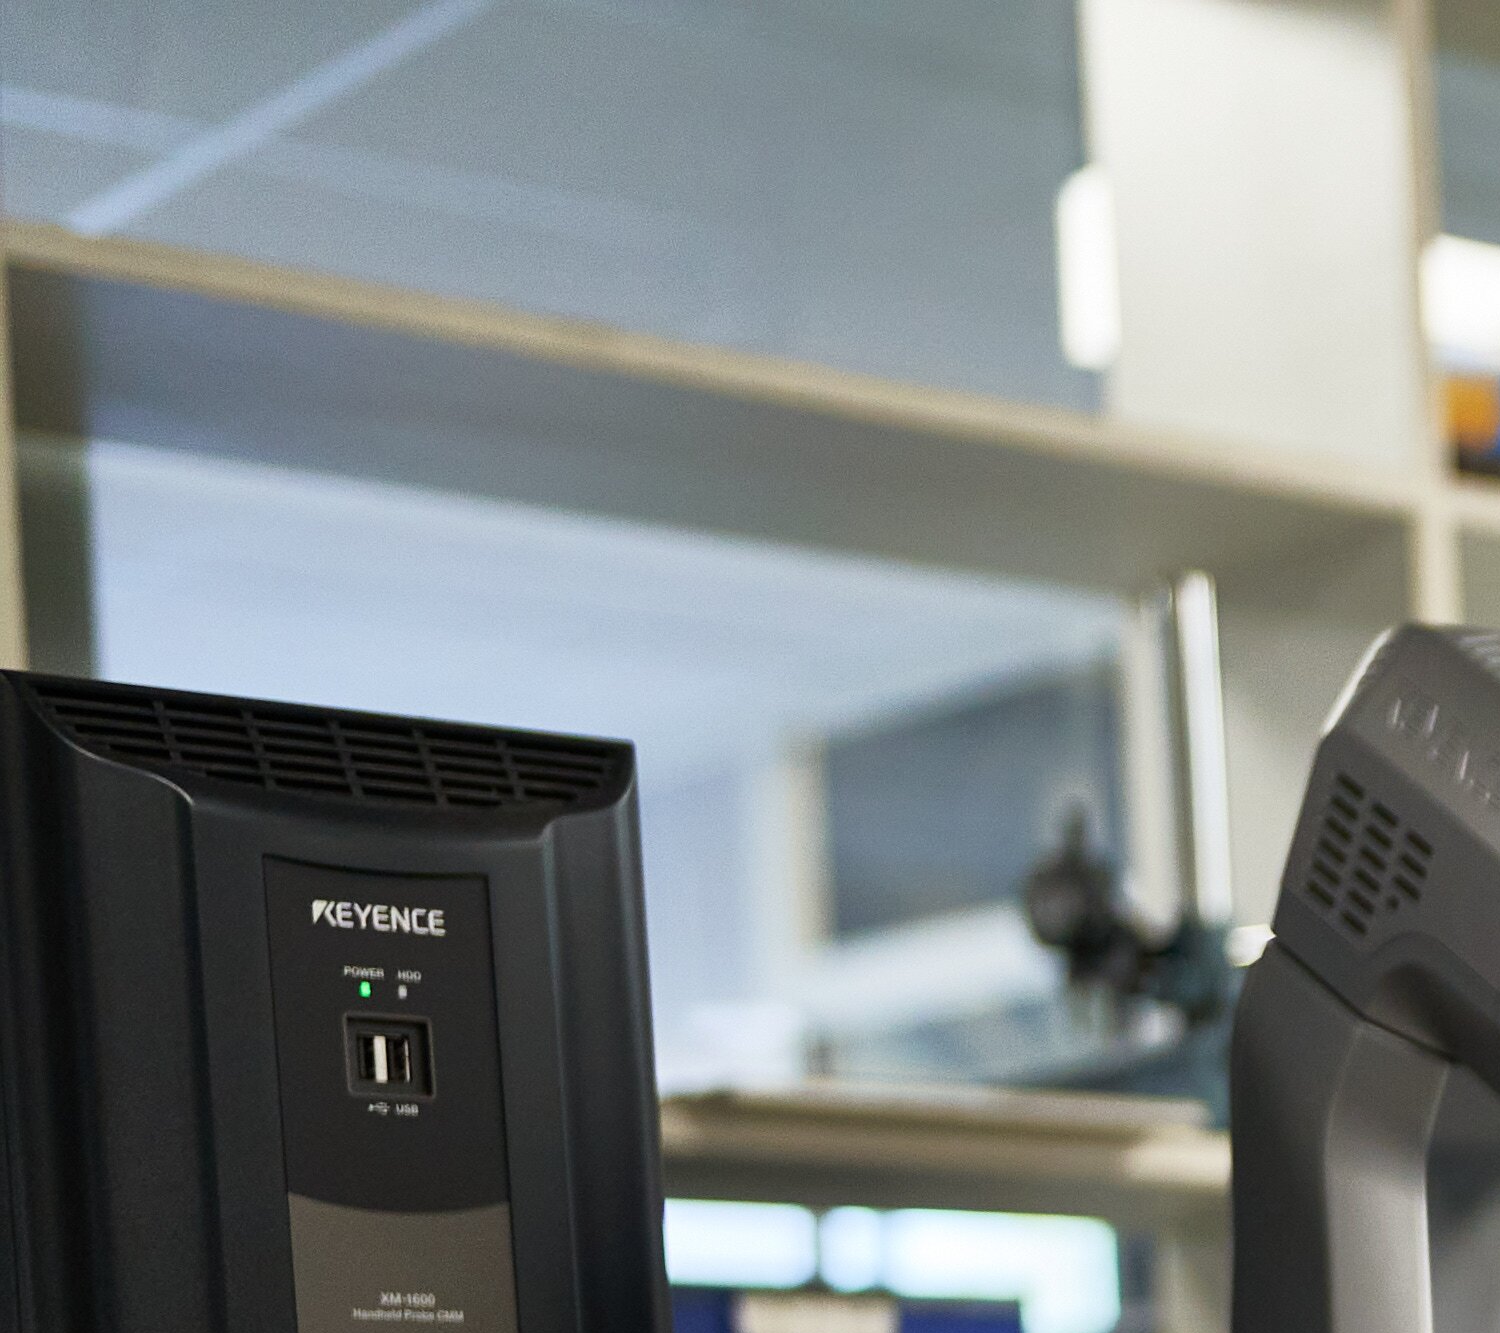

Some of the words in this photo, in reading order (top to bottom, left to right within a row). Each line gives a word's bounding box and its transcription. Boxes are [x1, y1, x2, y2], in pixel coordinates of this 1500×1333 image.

[312, 899, 446, 936] KEYENCE
[343, 965, 384, 979] POWER
[397, 970, 422, 983] HDD
[396, 1103, 418, 1117] USB
